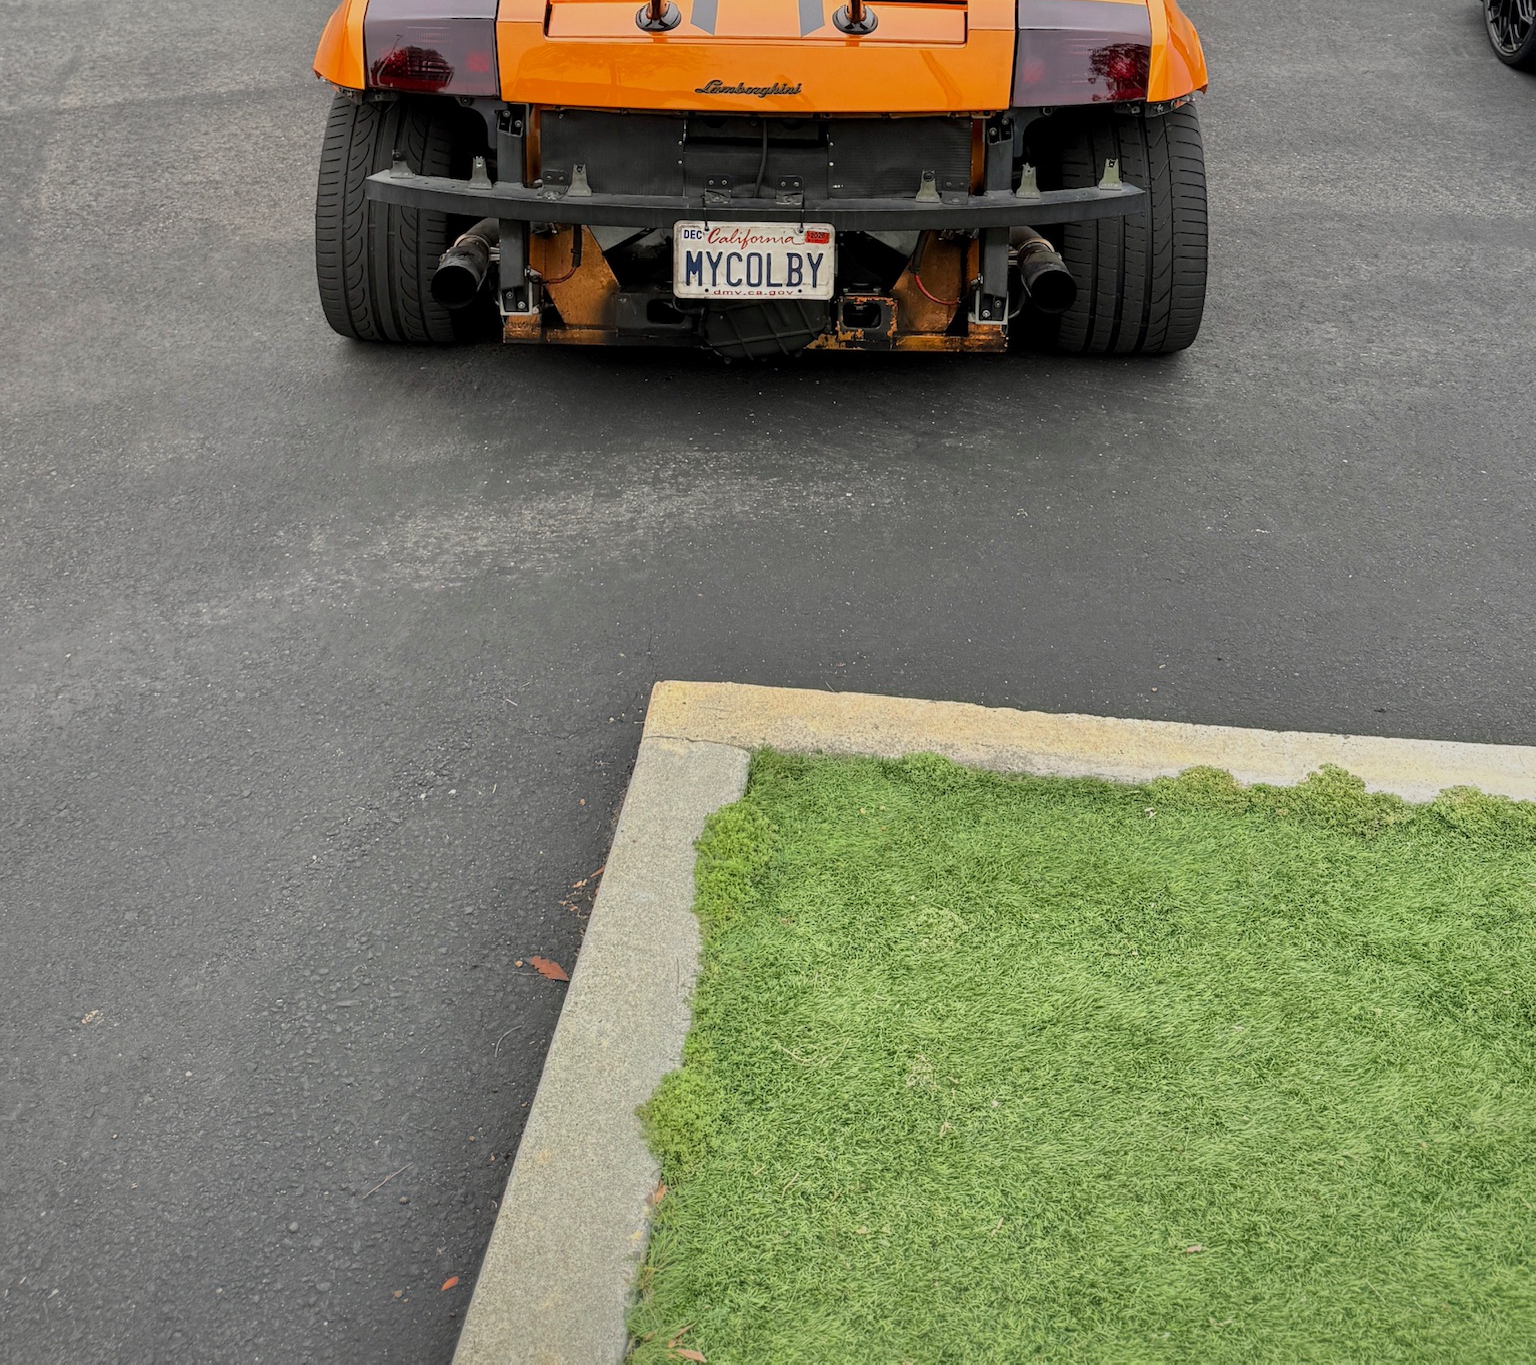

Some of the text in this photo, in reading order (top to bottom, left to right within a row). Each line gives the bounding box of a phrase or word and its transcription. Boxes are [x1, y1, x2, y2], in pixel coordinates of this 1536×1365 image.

[694, 79, 803, 99] Lamborghini
[683, 229, 703, 240] DEC
[707, 227, 806, 250] California
[685, 250, 825, 288] MYCOLBY
[713, 288, 795, 297] dmv.ca.gov
